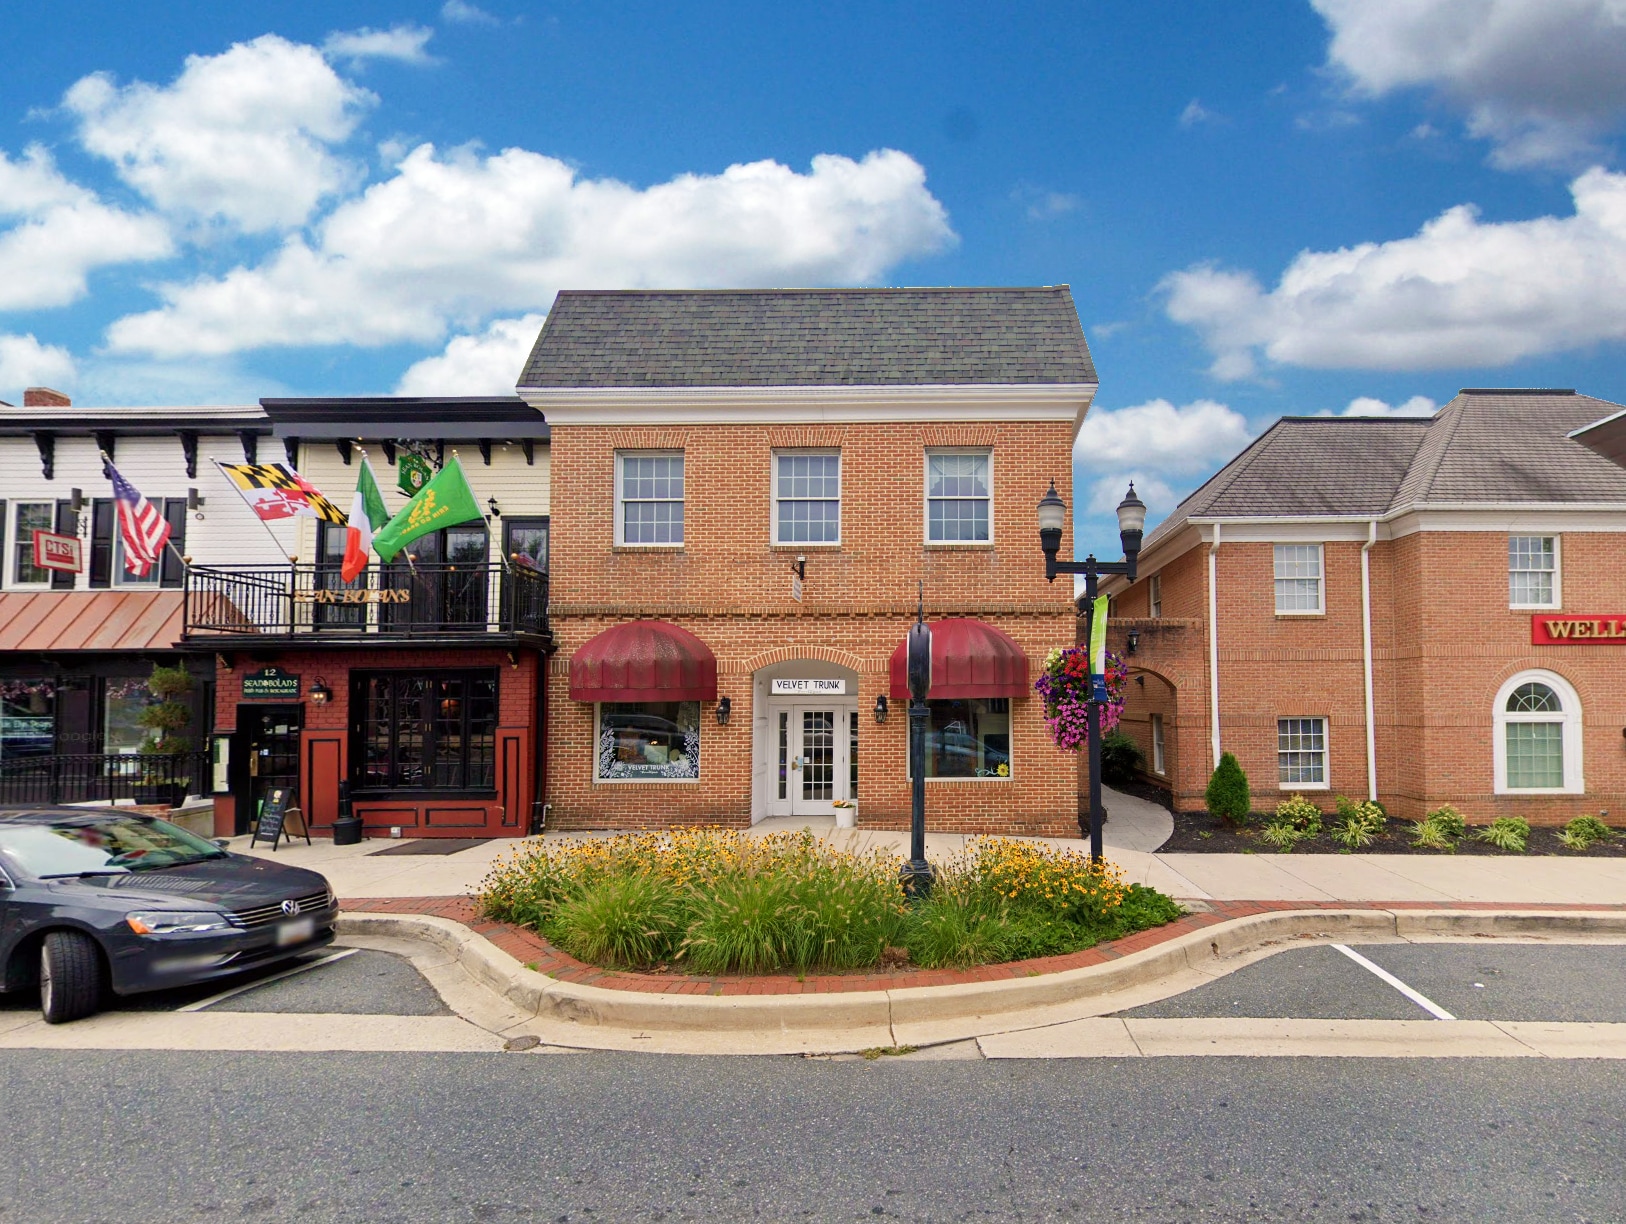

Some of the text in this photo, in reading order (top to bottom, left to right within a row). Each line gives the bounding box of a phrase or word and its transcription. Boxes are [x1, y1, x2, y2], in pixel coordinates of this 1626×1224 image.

[264, 668, 277, 676] 12
[776, 681, 840, 689] VELVET TRUNK
